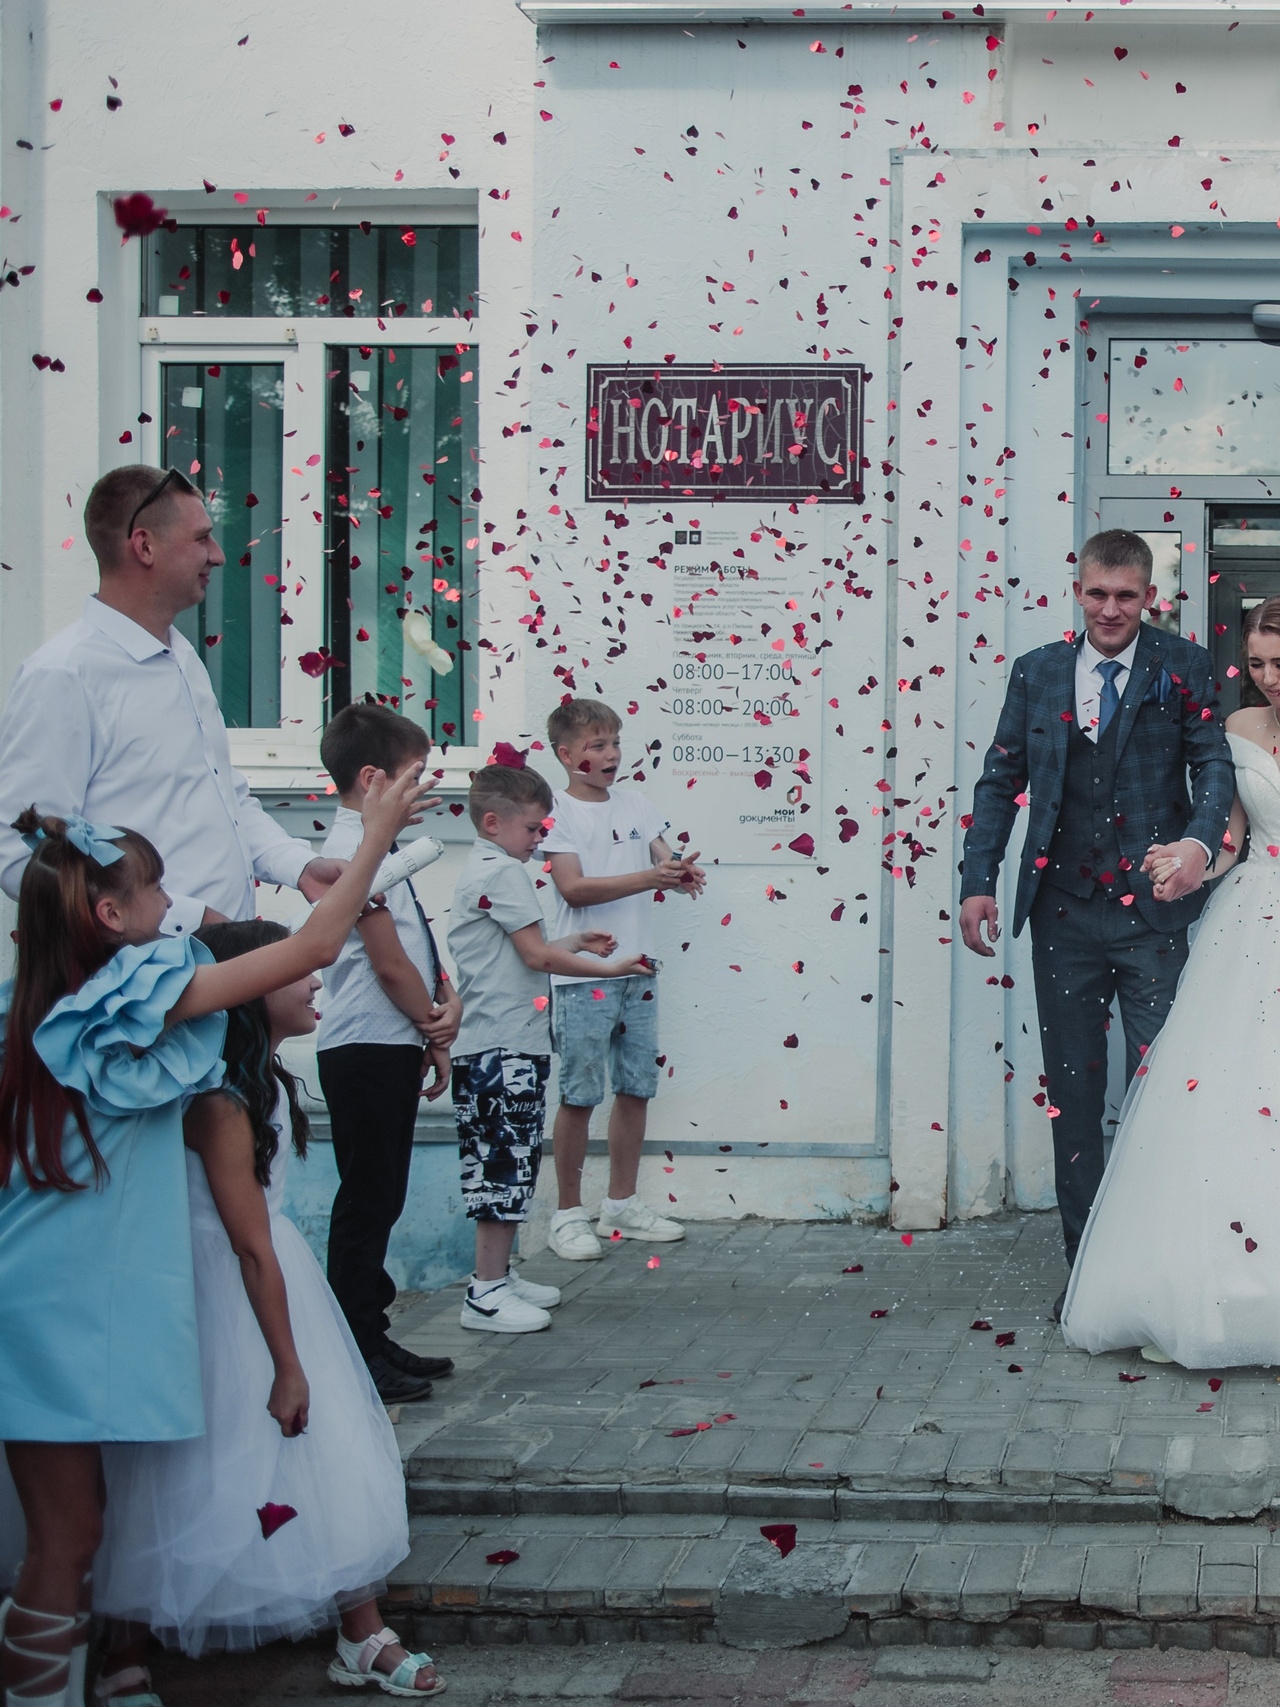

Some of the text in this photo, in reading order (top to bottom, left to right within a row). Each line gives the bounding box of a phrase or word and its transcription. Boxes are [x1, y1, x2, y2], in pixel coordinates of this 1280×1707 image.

[609, 394, 841, 465] НОТАРИУС
[674, 564, 709, 574] РЕЖИМ
[726, 652, 759, 660] вторник,
[760, 652, 784, 660] среда,
[672, 686, 703, 695] Четверг
[672, 732, 702, 742] Суббота
[739, 815, 795, 825] документы
